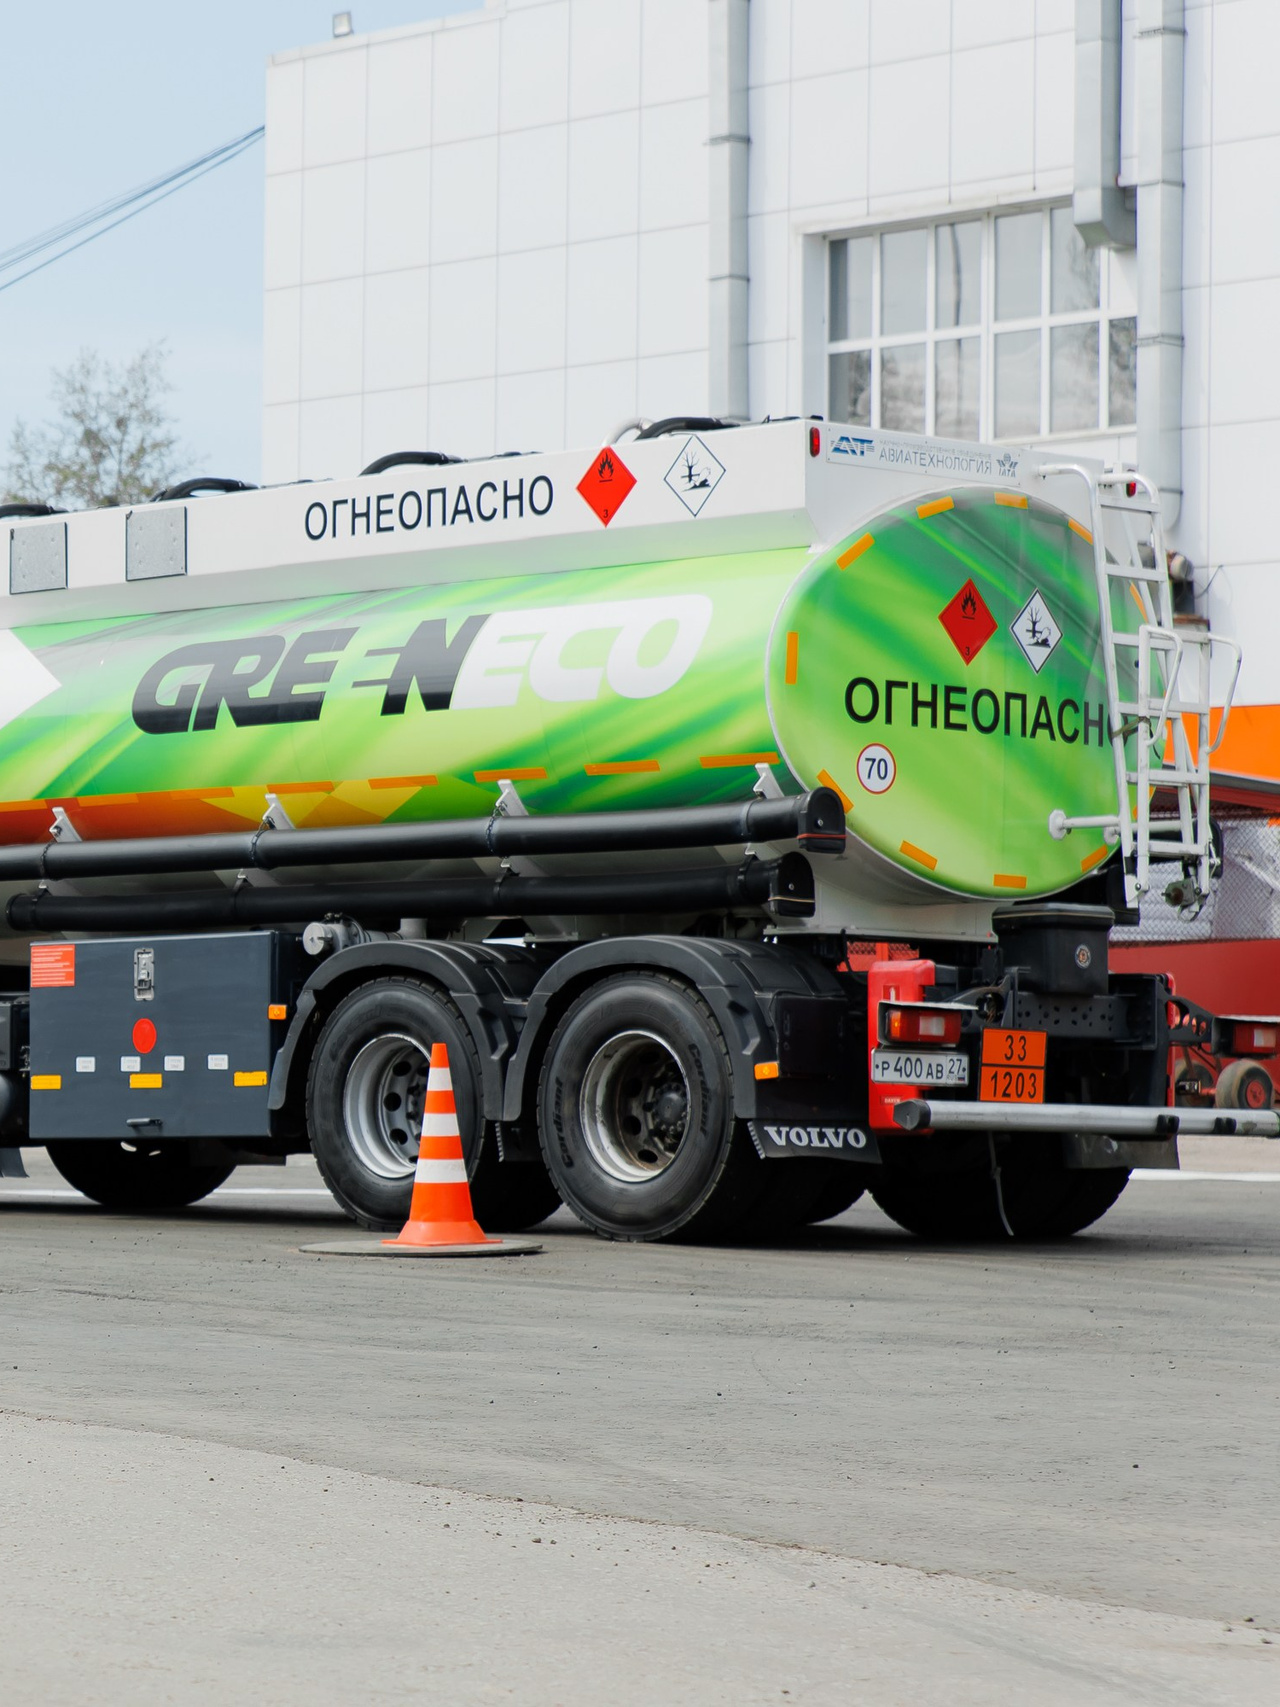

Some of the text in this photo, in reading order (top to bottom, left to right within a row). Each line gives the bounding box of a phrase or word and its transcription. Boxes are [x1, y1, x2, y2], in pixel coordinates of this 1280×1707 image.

[879, 447, 992, 475] АВИАТЕХНОЛОГИЯ
[304, 474, 554, 541] ОГНЕОПАСНО
[602, 508, 610, 519] 3
[964, 645, 971, 657] 3
[864, 757, 889, 780] 70
[1005, 1034, 1027, 1062] 33
[990, 1071, 1038, 1099] 1203
[764, 1125, 867, 1148] VOLVO
